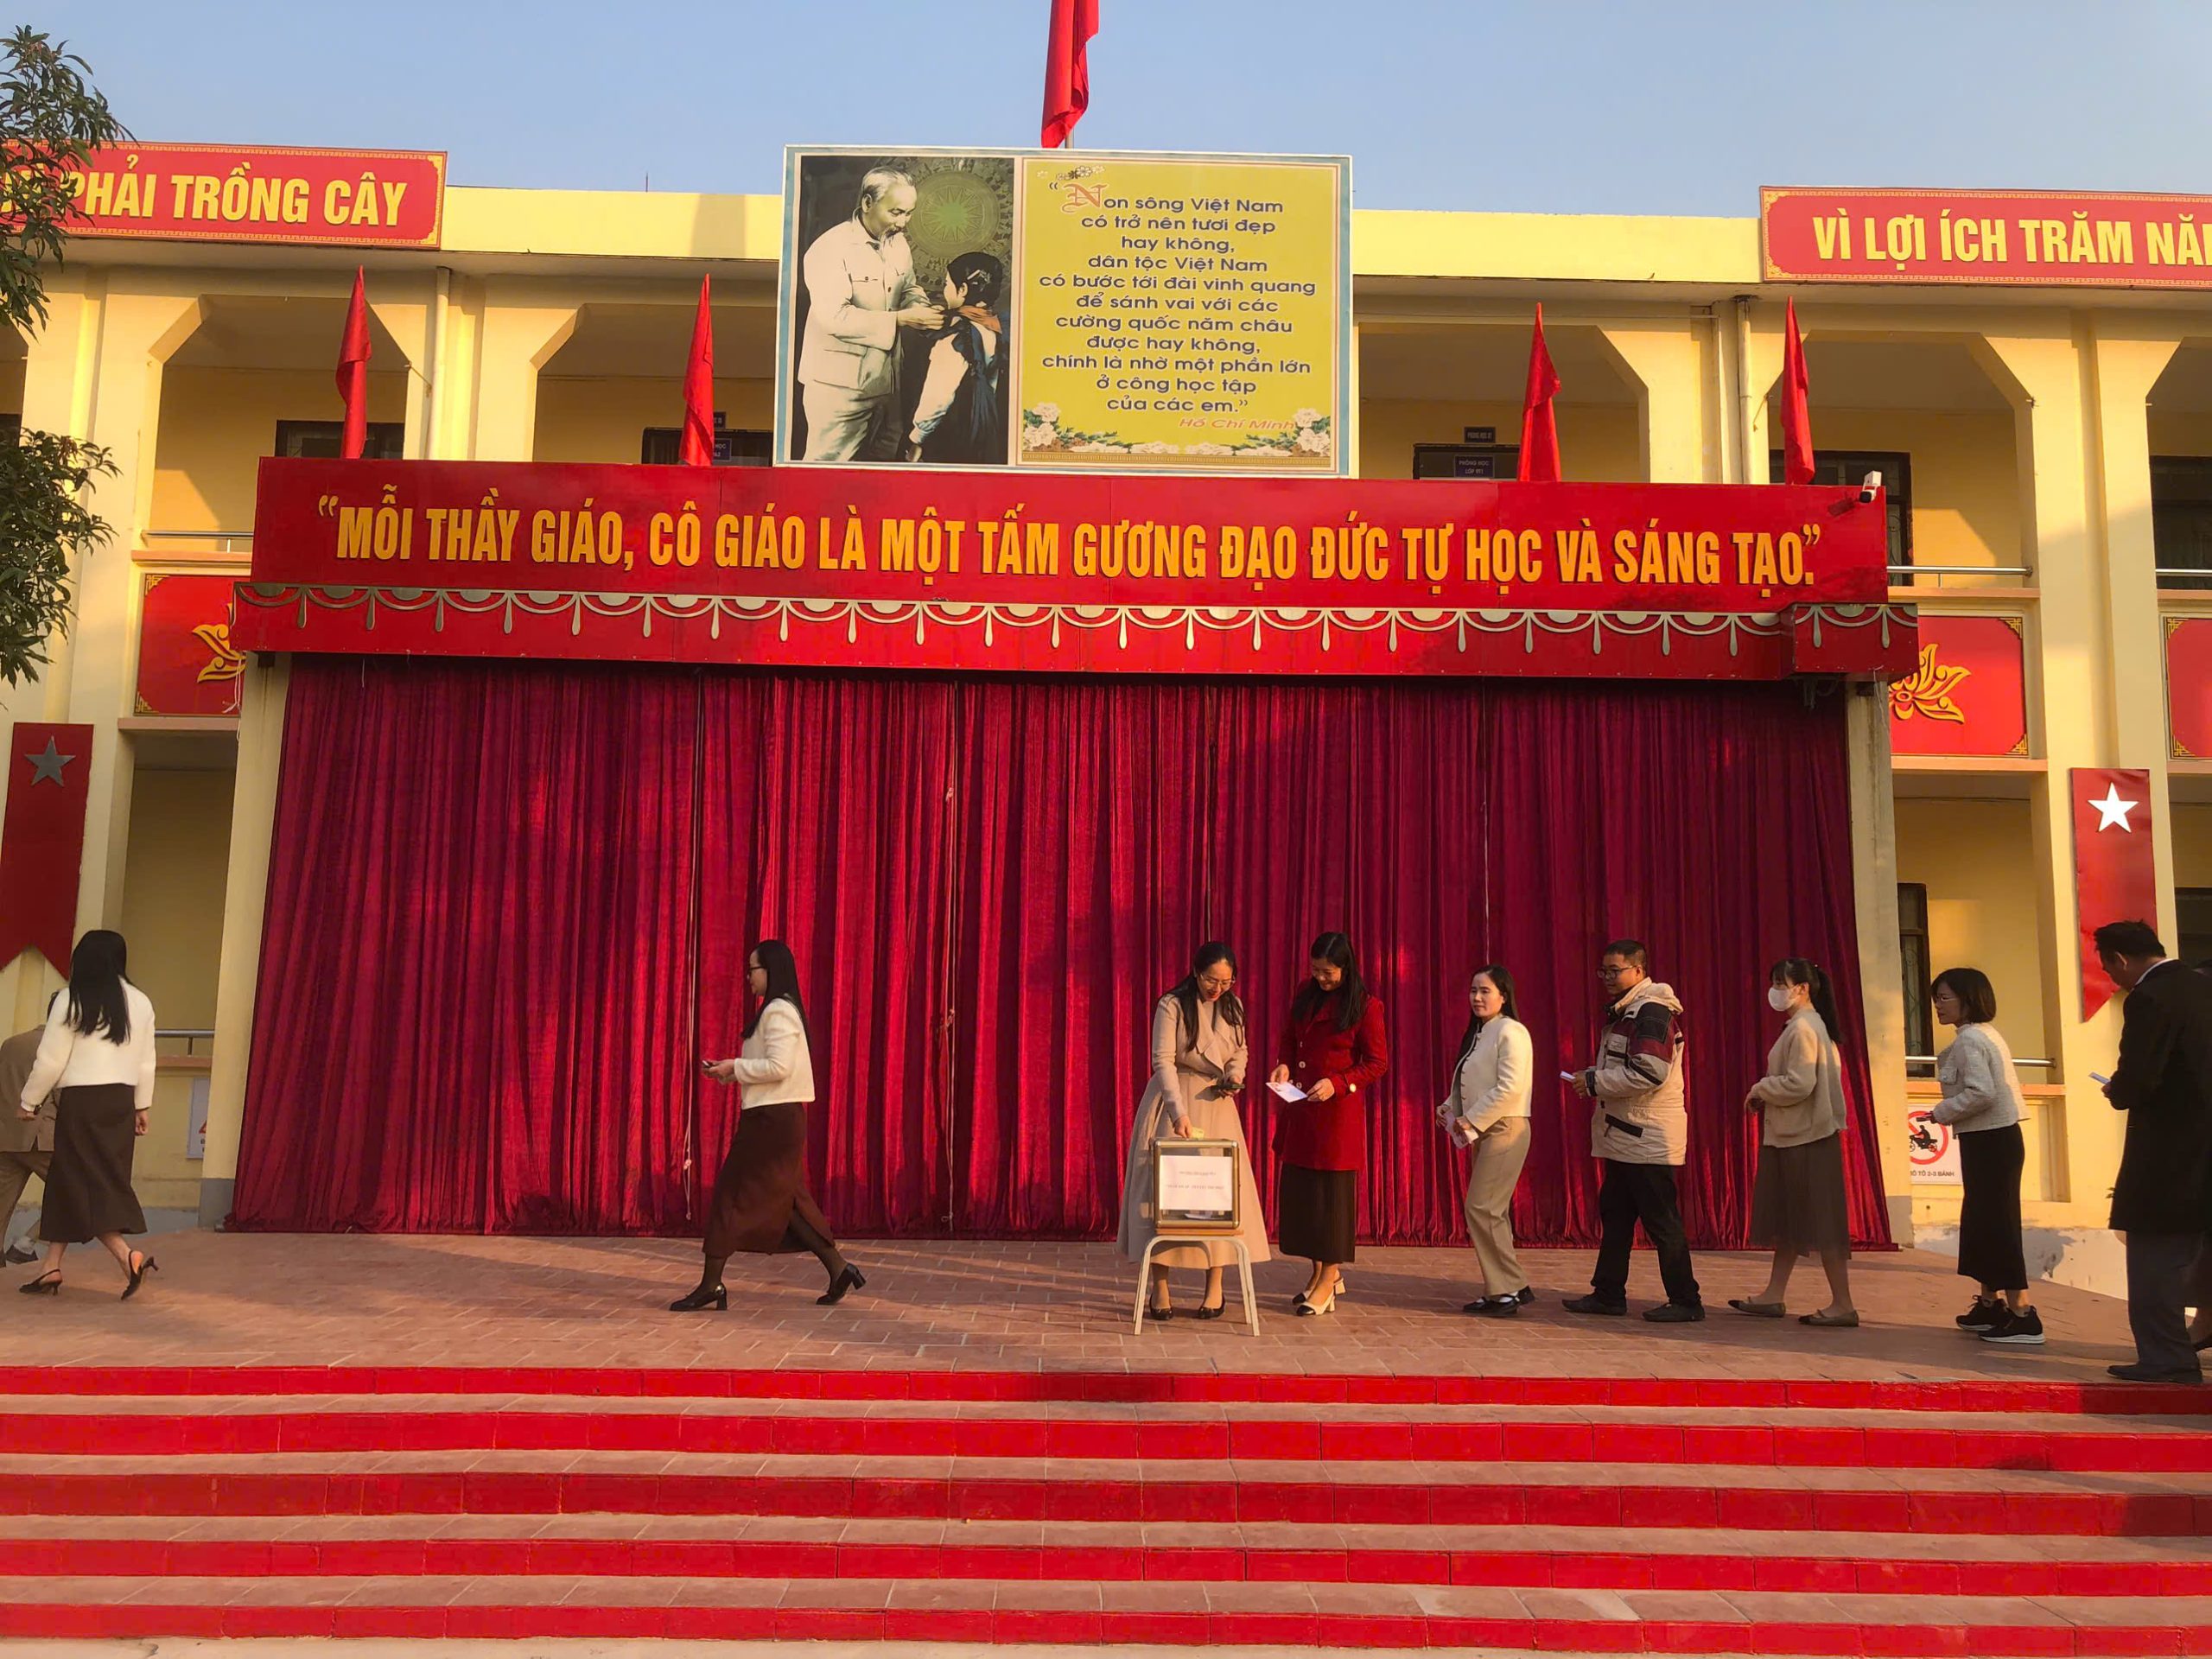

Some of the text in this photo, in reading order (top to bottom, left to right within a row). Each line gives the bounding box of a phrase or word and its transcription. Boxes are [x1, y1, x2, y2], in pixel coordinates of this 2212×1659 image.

[60, 154, 157, 218] PHẢI
[171, 162, 310, 224] TRỒNG
[324, 172, 407, 226] CÂY
[1135, 196, 1184, 213] sông
[1191, 197, 1230, 213] Việt
[1236, 199, 1283, 213] Nam
[1081, 213, 1275, 235] có trở nên tươi đẹp
[1122, 236, 1235, 254] hay không,
[1812, 208, 1852, 259] VÌ
[1865, 214, 1926, 270] LỢI
[1941, 209, 2007, 262] ÍCH
[2019, 210, 2133, 264] TRĂM
[1088, 255, 1268, 272] dân tộc Việt Nam
[1039, 274, 1316, 296] có bước tới đài vinh quang
[1077, 292, 1279, 312] để sánh vai với các
[1055, 315, 1293, 334] cường quốc năm châu
[1086, 335, 1261, 355] được hay không,
[1042, 354, 1311, 377] chính là nhờ một phần lớn
[1096, 374, 1257, 395] ở công học tập
[1107, 395, 1147, 411] của
[1154, 397, 1195, 412] các
[1249, 418, 1296, 430] Minh
[426, 487, 520, 563] THẦY
[531, 498, 633, 571] GIÁO,
[649, 500, 701, 567] CÔ
[715, 503, 804, 569] GIÁO
[819, 505, 867, 570] LÀ
[880, 506, 965, 585] MỘT
[977, 503, 1059, 575] TẤM
[1073, 520, 1206, 578] GƯƠNG
[1220, 525, 1297, 591] ĐẠO
[1311, 511, 1389, 580] ĐỨC
[1402, 523, 1453, 594] TỰ
[1466, 528, 1541, 594] HỌC
[1556, 518, 1603, 582] VÀ
[1613, 518, 1720, 584] SÁNG
